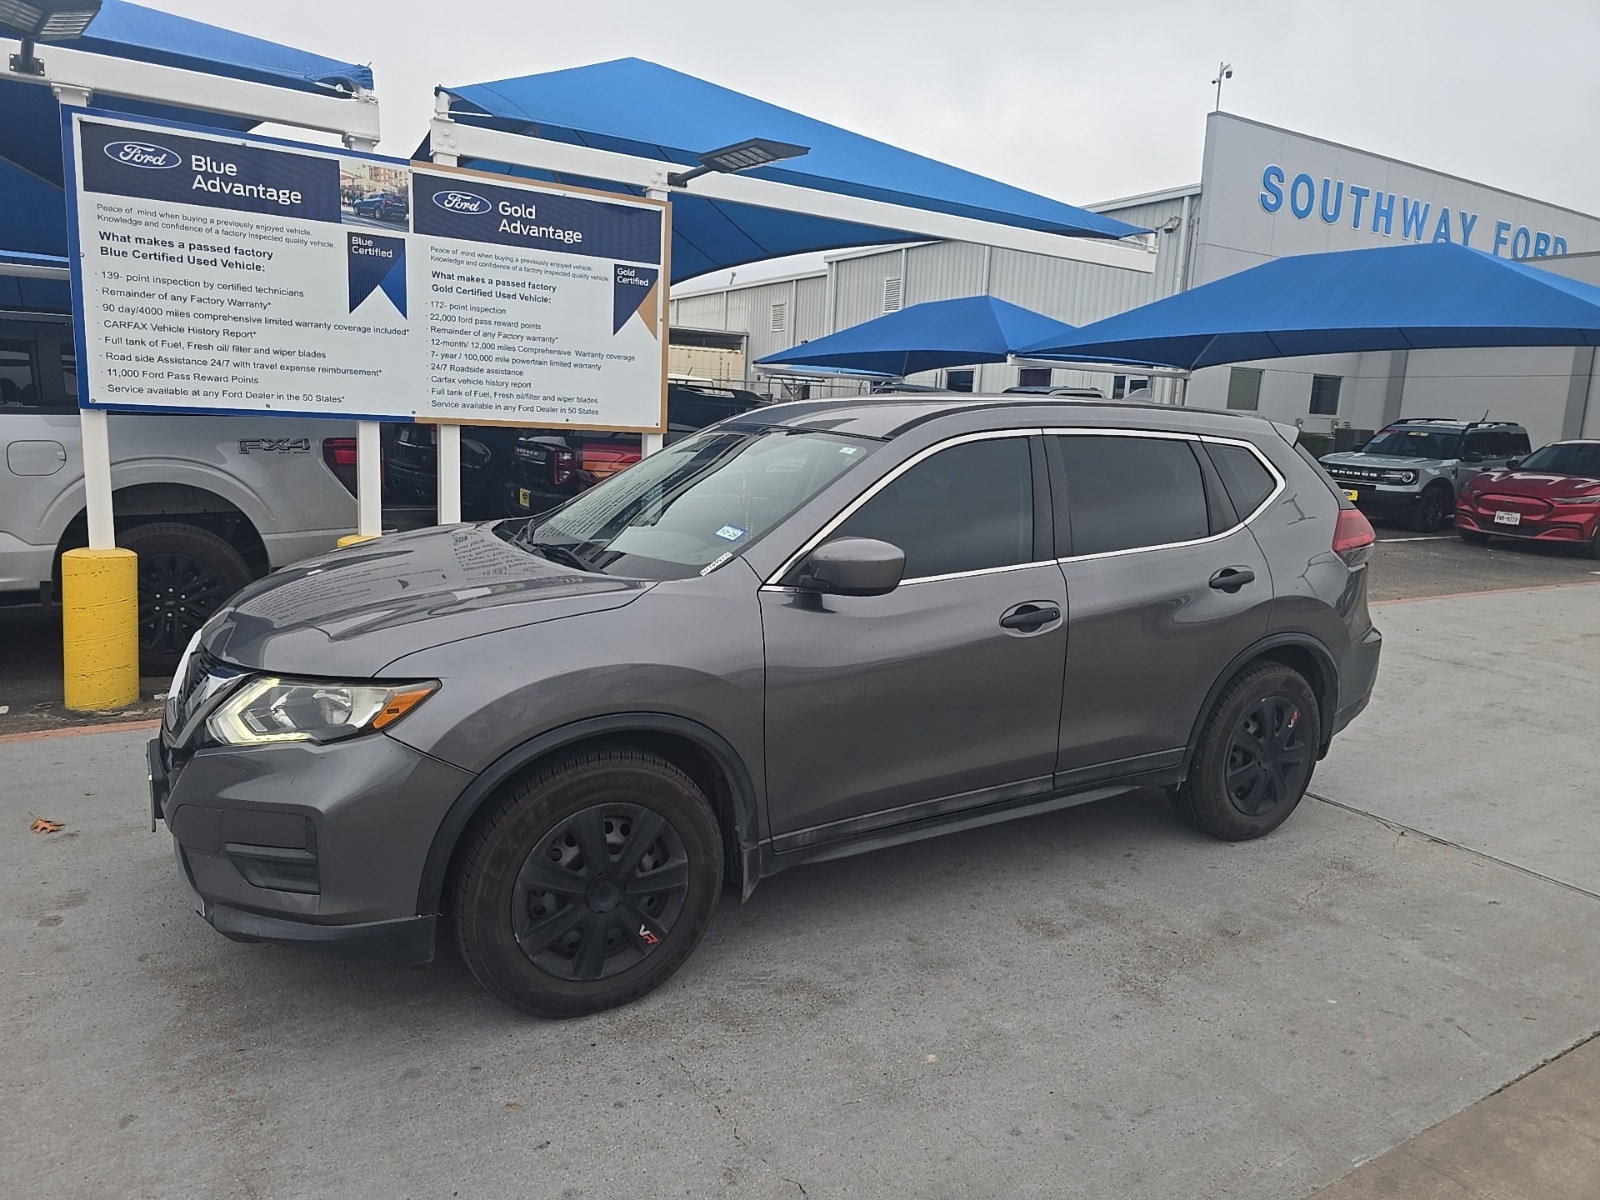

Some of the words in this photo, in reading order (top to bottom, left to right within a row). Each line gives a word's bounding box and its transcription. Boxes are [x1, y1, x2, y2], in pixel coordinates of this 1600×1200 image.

[118, 143, 167, 167] Ford
[190, 154, 238, 176] Blue
[191, 174, 302, 205] Advantage
[443, 191, 480, 212] Ford
[498, 200, 536, 219] Gold
[96, 202, 123, 214] Peace
[124, 206, 133, 215] of
[136, 208, 157, 218] mind
[157, 211, 180, 220] when
[181, 213, 208, 225] buying
[215, 219, 254, 230] previously
[255, 223, 284, 233] enjoyed
[1259, 164, 1479, 247] SOUTHWAY
[1492, 219, 1568, 260] FORD
[498, 218, 583, 244] Advantage
[97, 230, 132, 243] What
[134, 236, 175, 248] makes
[177, 241, 185, 249] a
[188, 242, 231, 254] passed
[233, 245, 274, 261] factory
[351, 236, 374, 247] Blue
[99, 245, 129, 258] Blue
[131, 249, 184, 263] Certified
[186, 254, 218, 267] Used
[351, 245, 393, 258] Certified
[430, 270, 455, 280] What
[456, 274, 486, 284] makes
[494, 279, 526, 288] passed
[527, 280, 557, 293] factory
[616, 267, 636, 277] Gold
[616, 275, 649, 286] Certified
[125, 273, 150, 283] point
[151, 275, 202, 288] inspection
[202, 279, 216, 291] by
[216, 282, 253, 293] certified
[254, 285, 304, 297] technicians
[431, 283, 453, 294] Gold
[455, 285, 493, 298] Certified
[494, 290, 517, 300] Used
[100, 286, 156, 299] Remainder
[157, 291, 168, 301] of
[169, 294, 188, 304] any
[189, 294, 226, 307] Factory
[101, 302, 115, 313] 90
[117, 304, 163, 316] day/4000
[164, 308, 191, 318] miles
[191, 312, 263, 324] comprehensive
[263, 316, 293, 327] limited
[294, 320, 331, 331] warranty
[332, 323, 372, 334] coverage
[448, 302, 468, 312] point
[469, 304, 507, 315] inspection
[103, 319, 148, 330] CARFAX
[149, 322, 185, 334] Vehicle
[187, 325, 221, 338] History
[429, 312, 457, 323] 22,000
[457, 314, 473, 324] ford
[474, 318, 493, 326] pass
[493, 320, 519, 328] reward
[520, 321, 542, 330] points
[429, 325, 473, 336] Remainder
[472, 329, 482, 337] of
[481, 330, 497, 340] any
[497, 330, 525, 342] Factory
[104, 335, 123, 345] Full
[124, 337, 147, 347] tank
[147, 338, 159, 348] of
[186, 341, 214, 351] Fresh
[215, 343, 230, 352] oil/
[231, 344, 252, 353] filter
[252, 346, 271, 355] and
[271, 347, 297, 357] wiper
[297, 349, 327, 359] blades
[470, 341, 496, 350] 12,000
[496, 343, 517, 352] miles
[516, 345, 572, 356] Comprehensive
[605, 353, 636, 363] coverage
[104, 351, 133, 362] Road
[134, 353, 155, 363] side
[156, 355, 208, 366] Assistance
[209, 358, 231, 367] 24/7
[231, 360, 251, 369] with
[252, 361, 278, 370] travel
[279, 364, 316, 373] expense
[439, 352, 458, 360] year
[463, 352, 494, 362] 100,000
[494, 355, 510, 364] mile
[510, 357, 548, 366] powertrain
[549, 359, 572, 368] limited
[572, 362, 602, 372] warranty
[448, 363, 485, 374] Roadside
[485, 367, 524, 377] assistance
[106, 367, 139, 378] 11,000
[141, 369, 165, 379] Ford
[166, 370, 191, 381] Pass
[192, 372, 229, 383] Reward
[230, 374, 259, 384] Points
[430, 375, 457, 384] Carfax
[456, 377, 484, 386] vehicle
[484, 378, 511, 389] history
[509, 381, 532, 389] report
[106, 383, 144, 394] Service
[146, 386, 189, 396] available
[190, 388, 201, 397] at
[201, 390, 221, 399] any
[221, 389, 245, 399] Ford
[244, 390, 275, 400] Dealer
[275, 391, 285, 400] in
[285, 392, 301, 401] the
[300, 393, 315, 402] 50
[430, 386, 445, 395] Full
[446, 388, 464, 396] tank
[463, 389, 473, 397] of
[493, 390, 515, 399] Fresh
[541, 394, 556, 402] and
[555, 395, 575, 403] wiper
[575, 396, 599, 404] blades
[430, 399, 460, 408] Service
[460, 401, 494, 410] available
[494, 402, 502, 411] in
[502, 404, 516, 413] any
[517, 404, 535, 413] Ford
[535, 405, 559, 413] Dealer
[559, 406, 567, 414] in
[566, 406, 577, 414] 50
[577, 406, 599, 416] States
[238, 438, 311, 454] FX4
